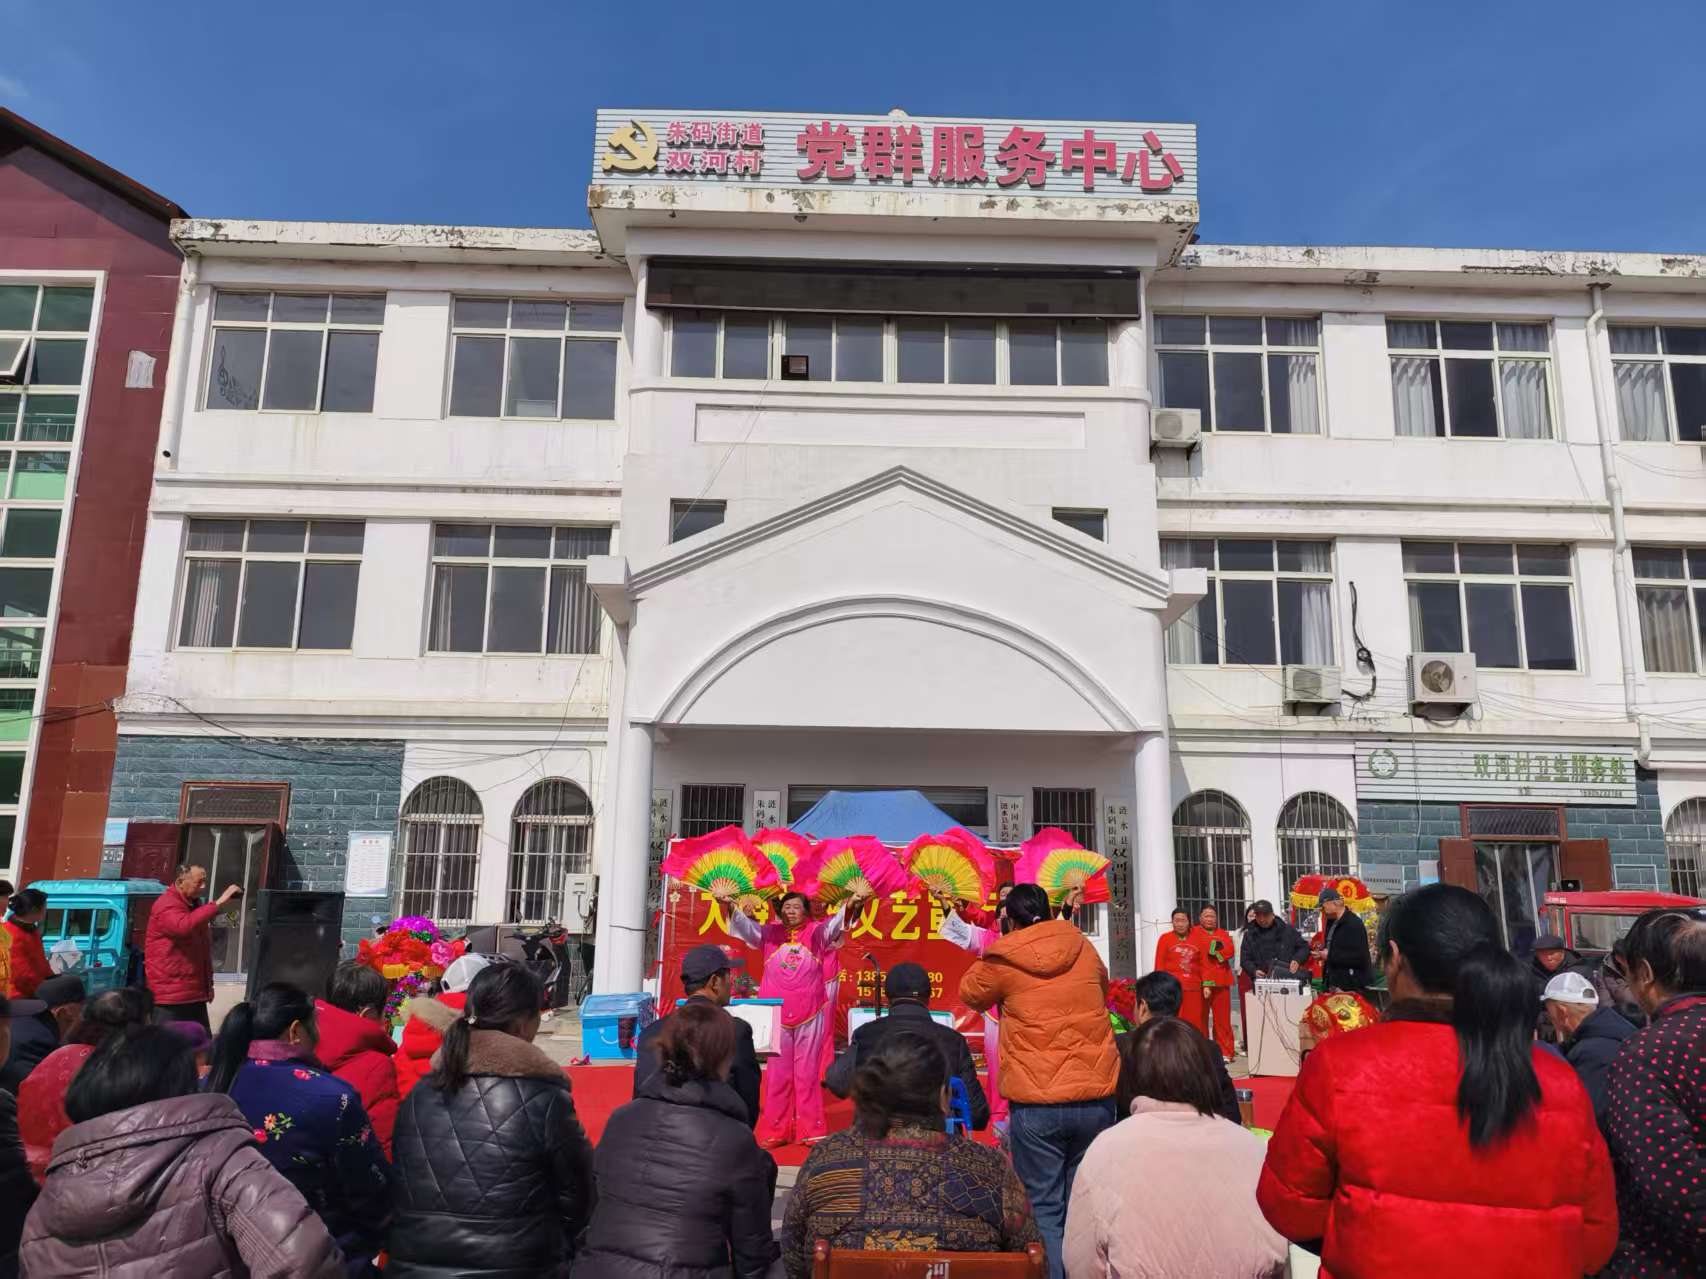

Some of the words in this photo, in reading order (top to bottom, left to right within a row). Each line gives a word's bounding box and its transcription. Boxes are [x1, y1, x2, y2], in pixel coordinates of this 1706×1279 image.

[667, 121, 764, 147] 朱码街道
[666, 150, 763, 174] 双河村
[796, 121, 1184, 190] 党群服务中心
